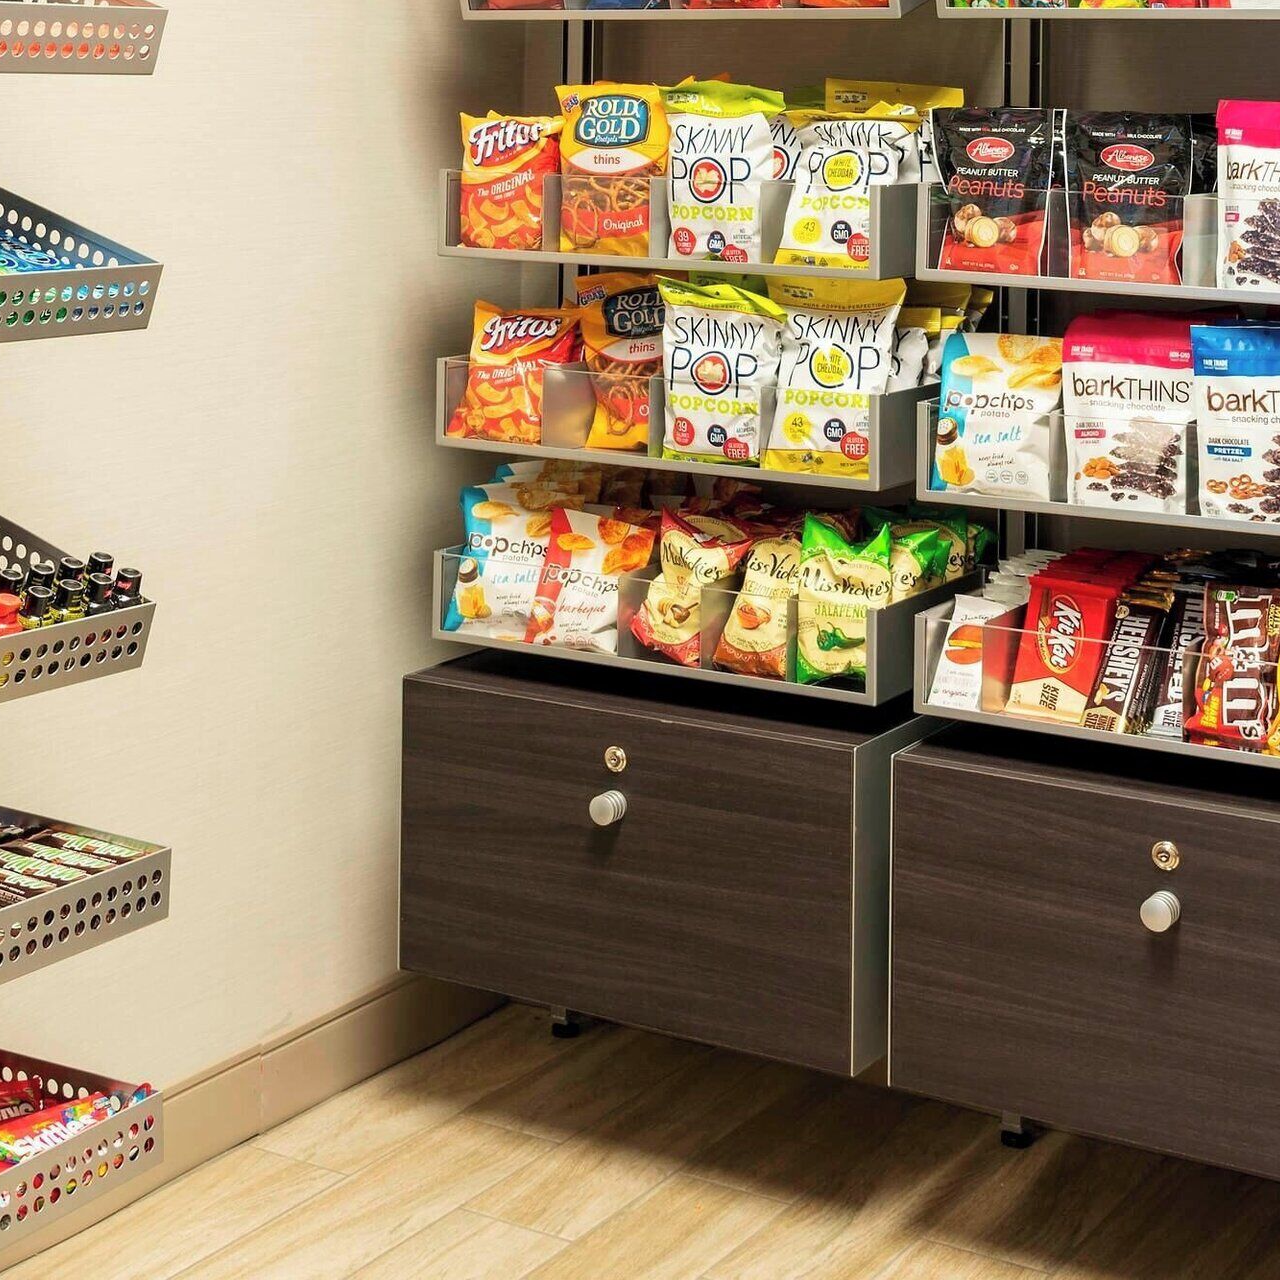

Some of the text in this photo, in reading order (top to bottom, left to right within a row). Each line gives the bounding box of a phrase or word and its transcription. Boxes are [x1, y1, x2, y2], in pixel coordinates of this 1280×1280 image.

[585, 96, 644, 119] ROLD
[579, 115, 643, 141] GOLD
[675, 124, 753, 154] SKINNY
[593, 154, 621, 166] thins
[672, 156, 751, 204] POP
[956, 167, 1019, 178] PEANUT BUTTER
[1092, 173, 1161, 186] PEANUT BUTTER
[948, 175, 1025, 199] Peanuts
[1082, 181, 1168, 207] Peanuts
[602, 217, 645, 233] Original
[672, 205, 754, 222] POPCORN
[481, 314, 561, 351] Fritos
[675, 317, 764, 350] SKINNY
[794, 313, 886, 342] SKINNY
[628, 342, 656, 354] thins
[670, 346, 758, 396] POP
[796, 342, 880, 390] POP
[1072, 372, 1190, 403] barkTHINS
[669, 395, 759, 416] POPCORN
[1231, 414, 1269, 426] snacking
[972, 426, 1022, 445] sea salt
[1213, 446, 1246, 456] PRETZEL
[490, 569, 538, 586] sea salt
